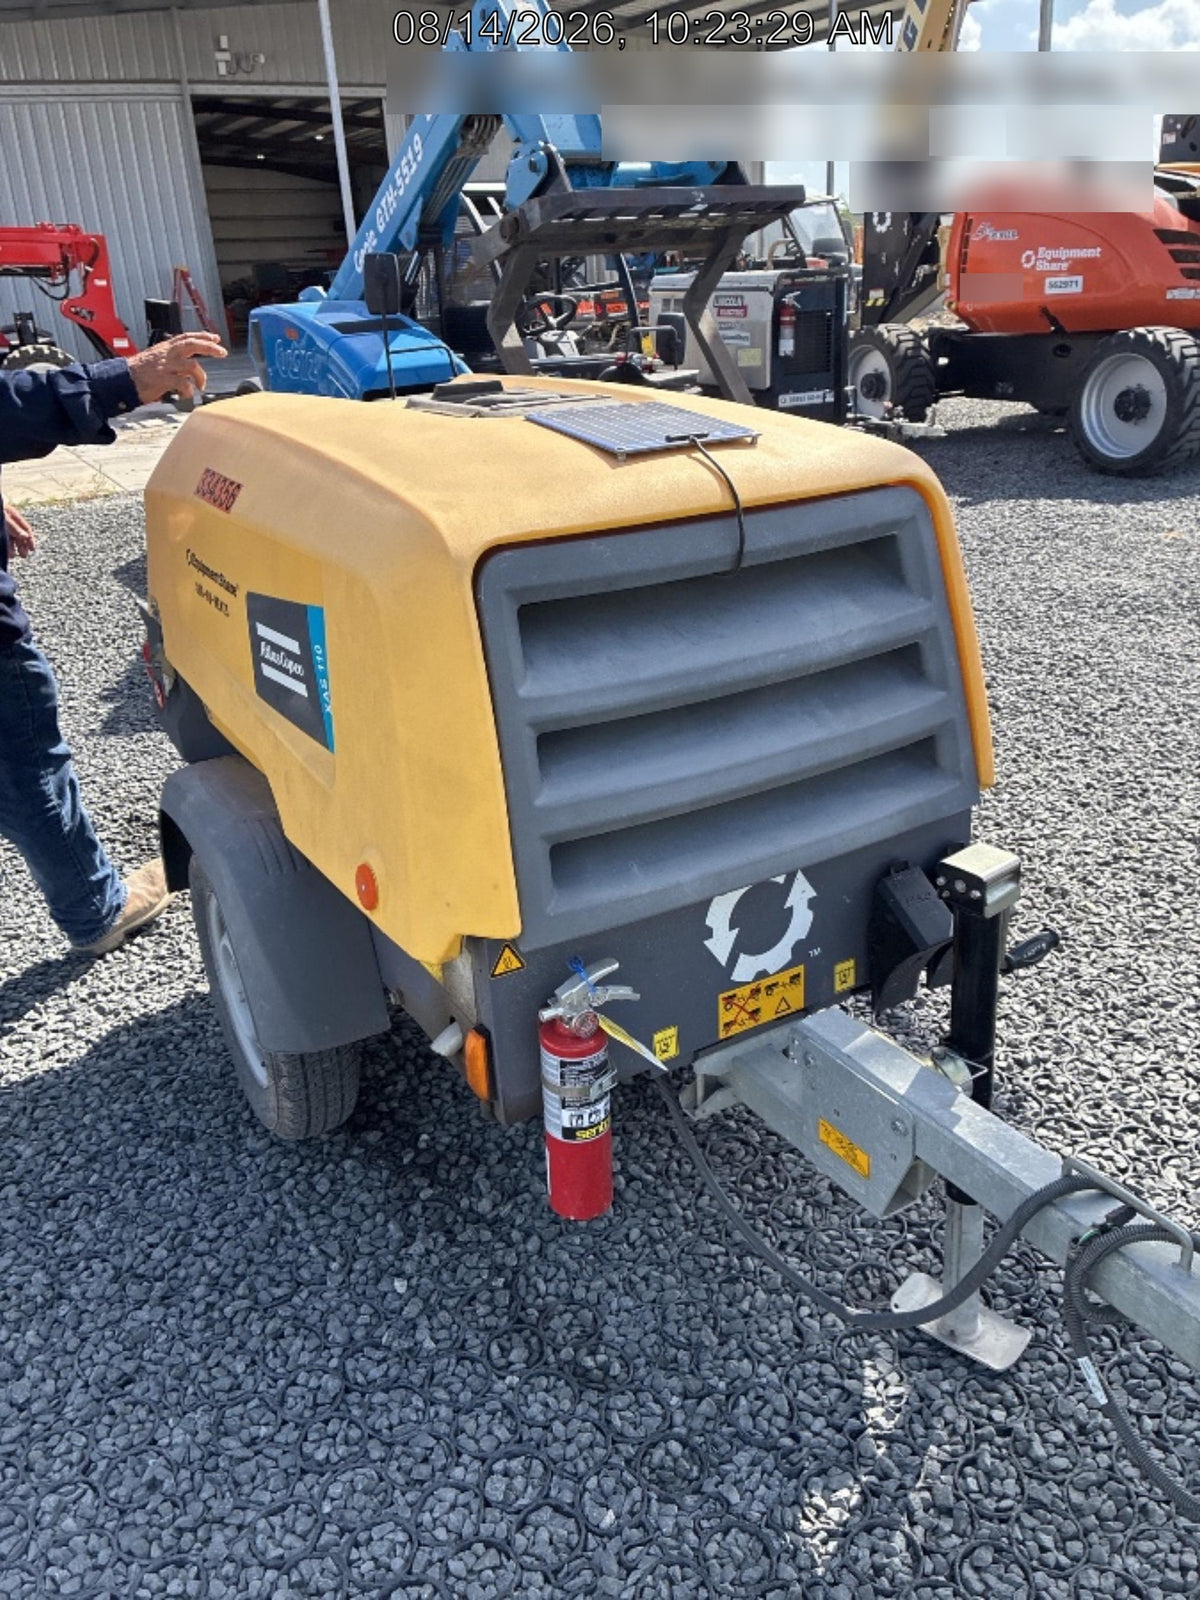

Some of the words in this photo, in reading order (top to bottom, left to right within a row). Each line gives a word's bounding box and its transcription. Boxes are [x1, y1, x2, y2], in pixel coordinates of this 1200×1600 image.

[376, 132, 424, 234] GTH-5519
[1037, 246, 1102, 260] Equipment
[1036, 260, 1069, 271] Share
[314, 644, 326, 671] 110
